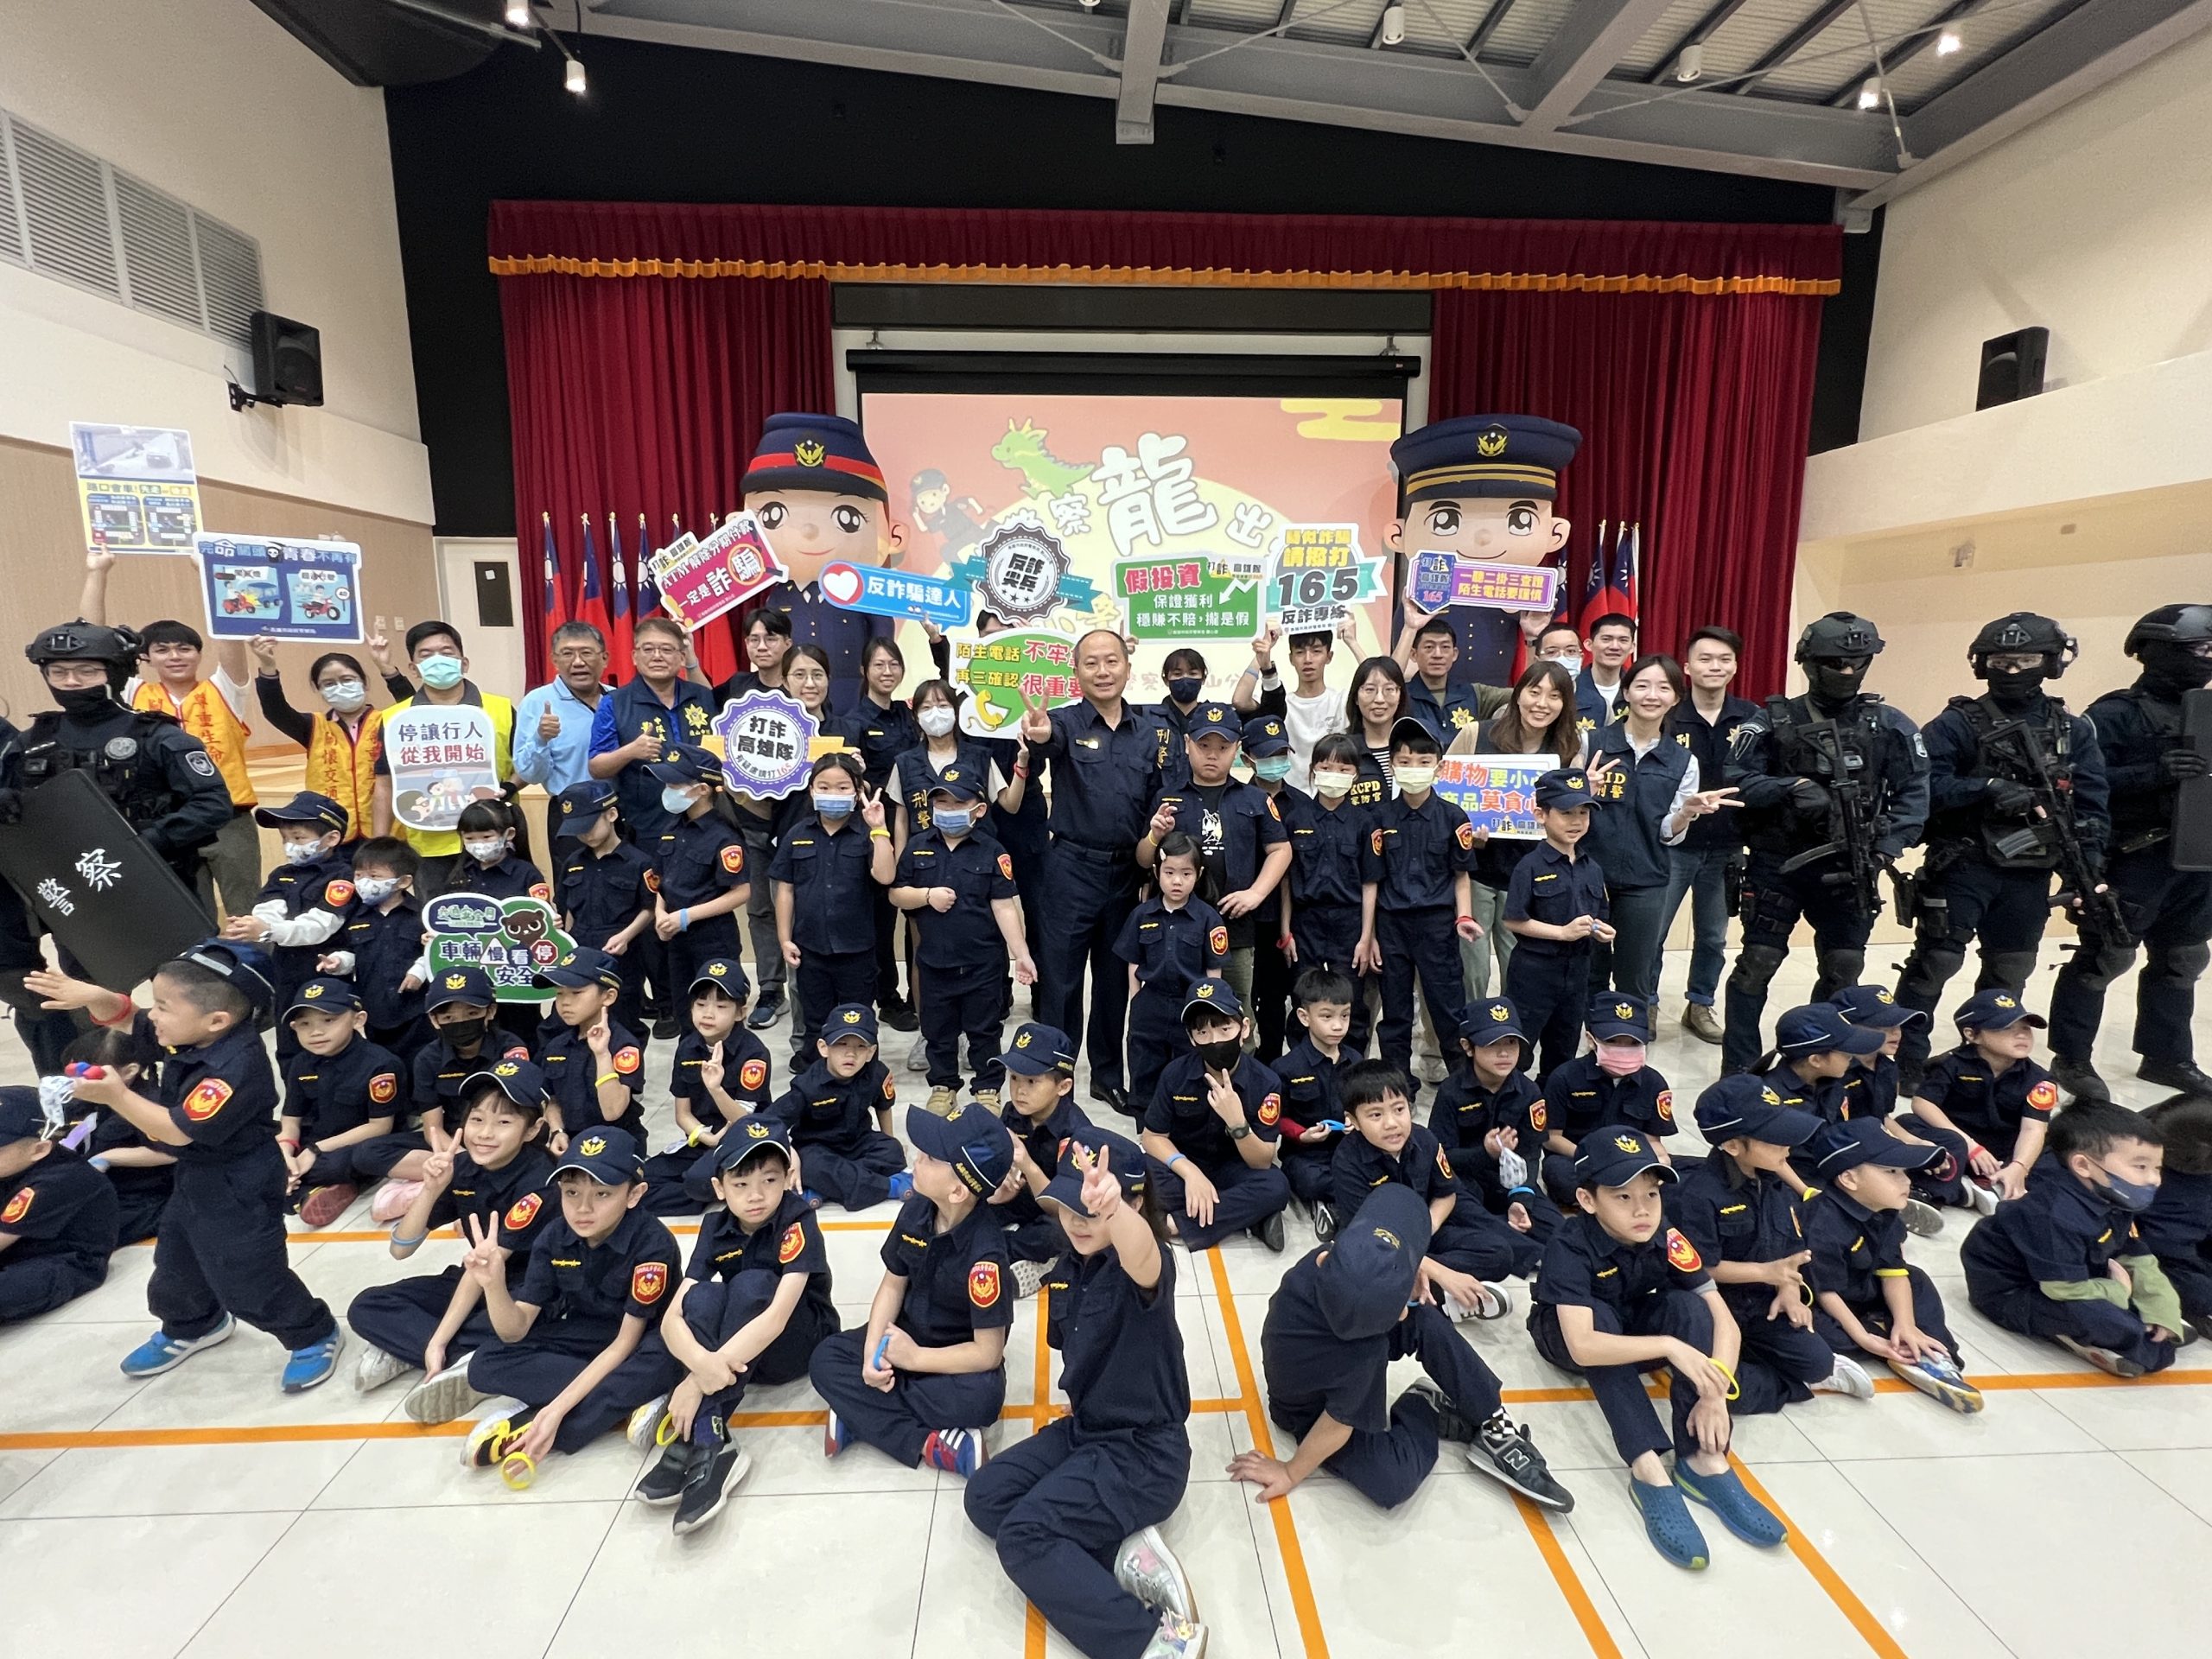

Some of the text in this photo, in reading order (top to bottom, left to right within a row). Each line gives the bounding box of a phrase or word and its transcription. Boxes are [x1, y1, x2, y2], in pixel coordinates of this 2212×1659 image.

[1008, 553, 1045, 575] 反詐
[1125, 563, 1202, 594] 假投資
[1279, 568, 1358, 606] 165
[867, 575, 962, 609] 反詐騙達人
[1154, 594, 1213, 609] 保證獲利
[1422, 590, 1444, 602] 165
[956, 642, 1021, 663] 陌生電話
[956, 668, 1020, 689] 再三確認
[398, 721, 484, 742] 停讓行人
[749, 715, 787, 738] 打詐
[399, 743, 486, 766] 從我開始
[738, 735, 794, 761] 高雄隊
[1605, 771, 1626, 785] ID
[37, 848, 123, 917] 警察
